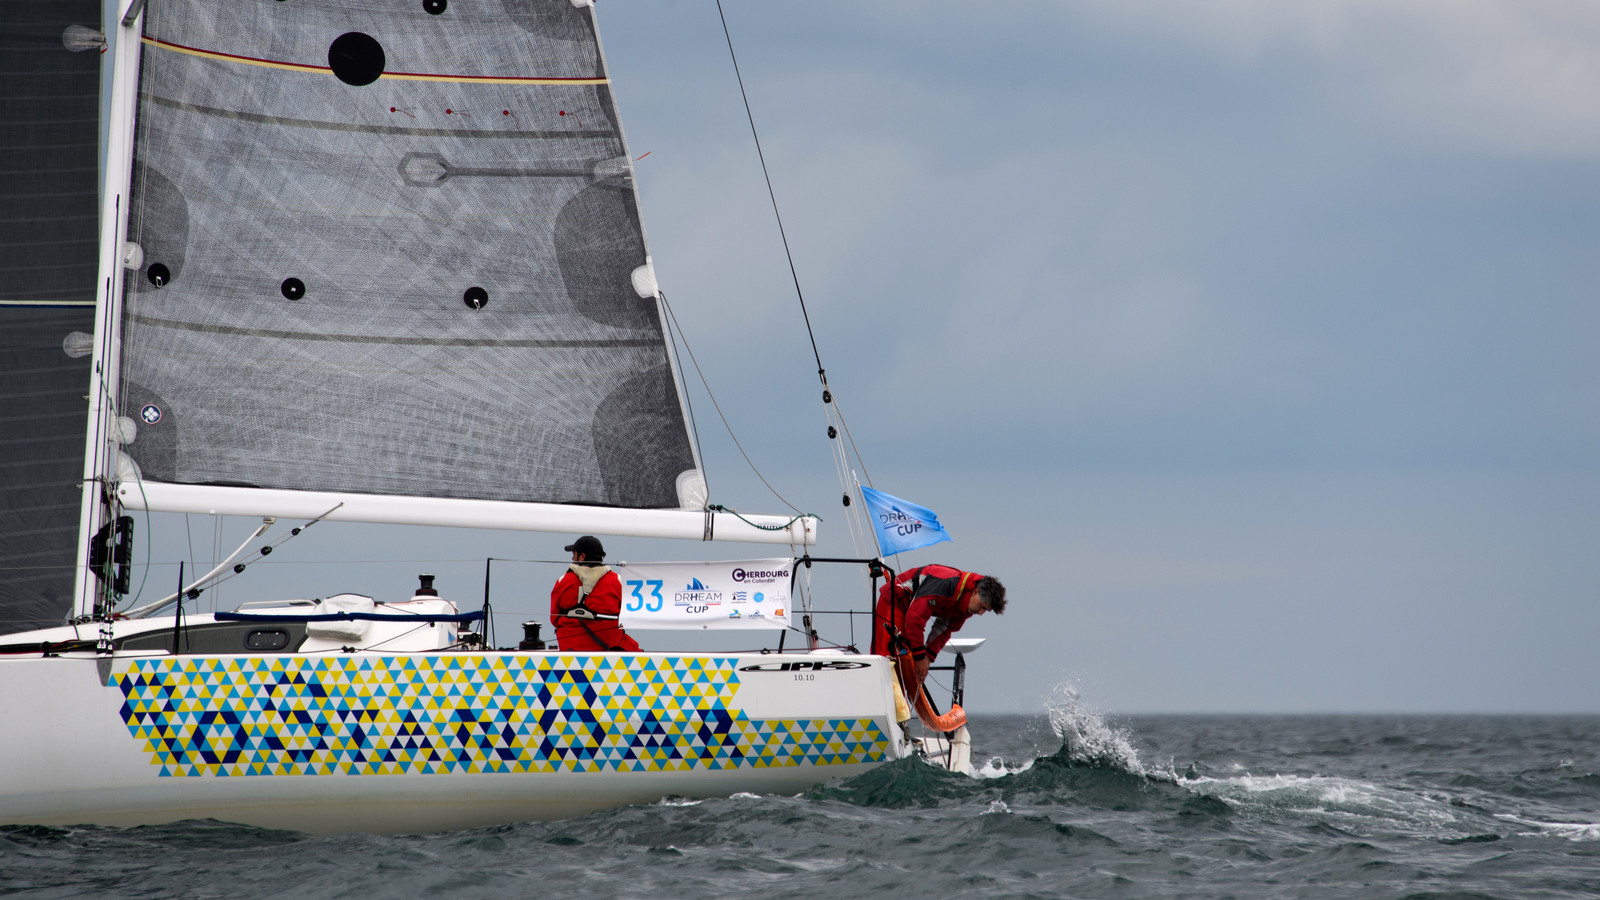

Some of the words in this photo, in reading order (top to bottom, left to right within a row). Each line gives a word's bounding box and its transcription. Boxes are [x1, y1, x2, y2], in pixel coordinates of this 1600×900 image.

[897, 523, 922, 536] CUP
[732, 568, 789, 582] CHERBOURG
[626, 580, 664, 612] 33
[674, 592, 722, 602] DRHEAM
[686, 605, 709, 614] CUP
[794, 674, 815, 682] 10.10
